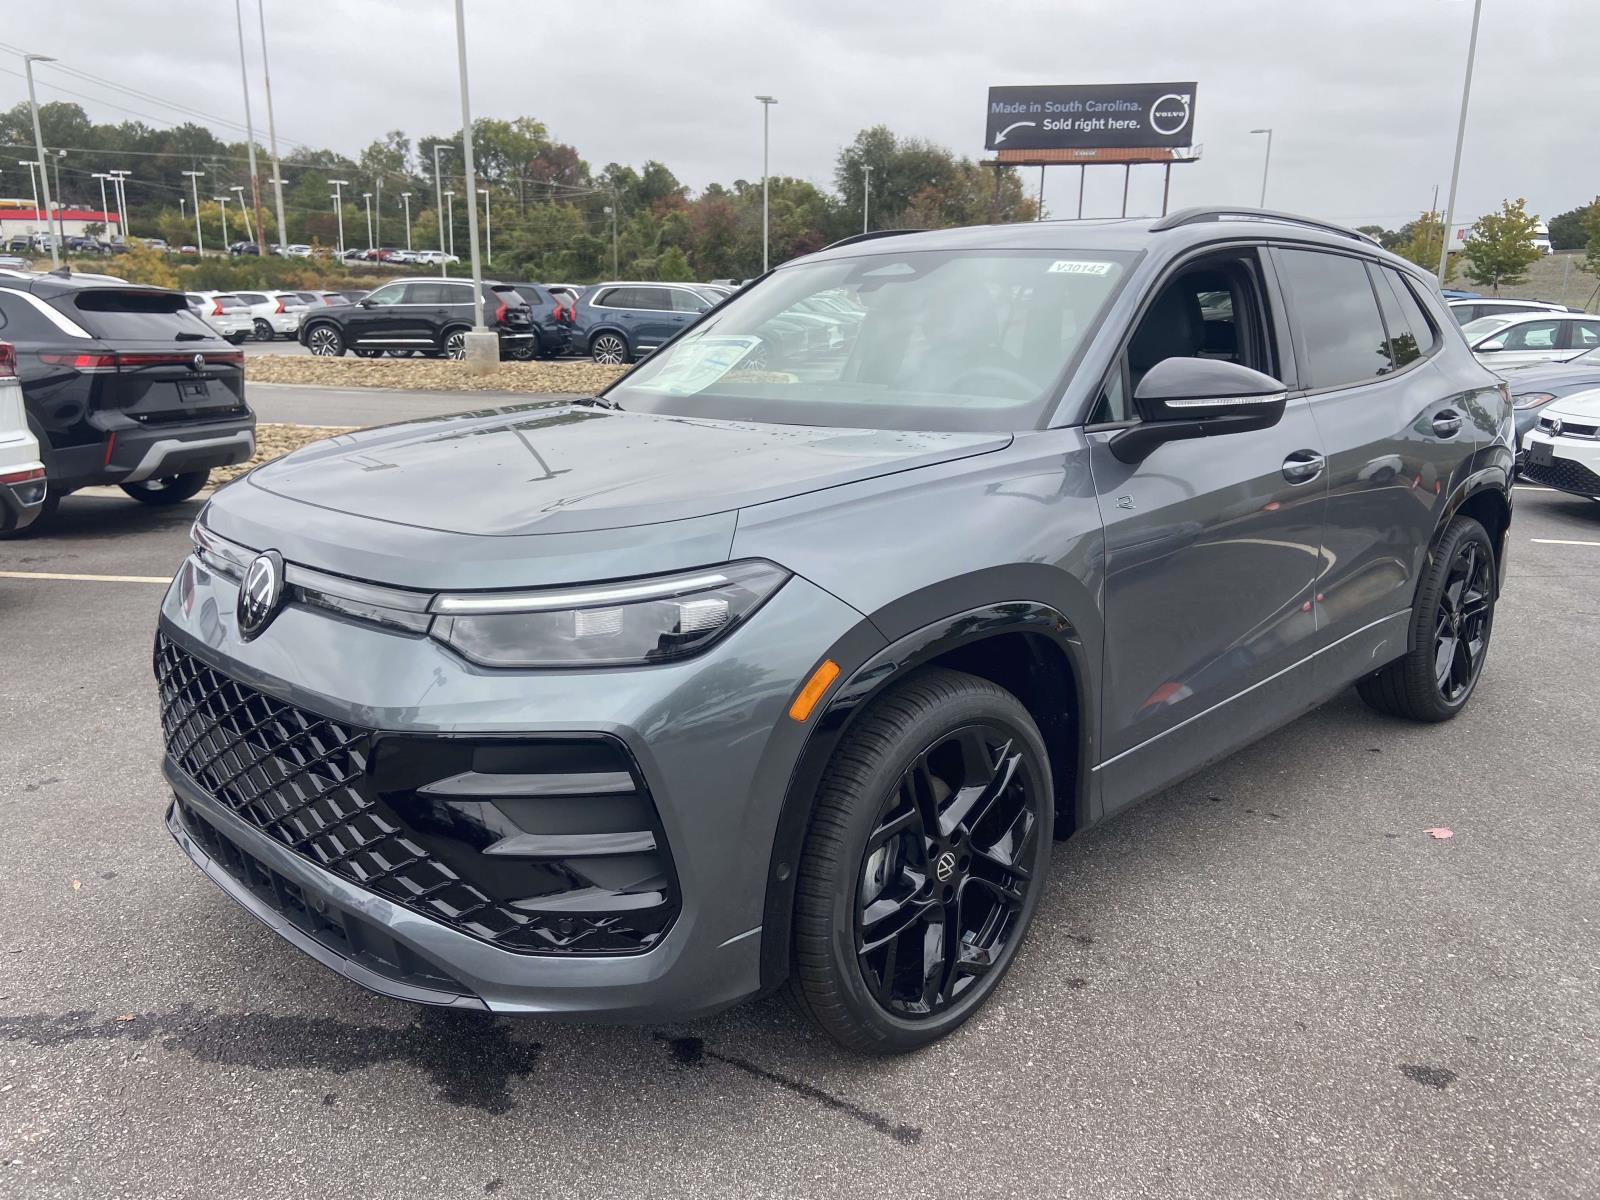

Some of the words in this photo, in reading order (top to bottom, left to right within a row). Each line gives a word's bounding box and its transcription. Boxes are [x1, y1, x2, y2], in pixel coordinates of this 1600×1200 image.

[992, 102, 1026, 113] Made
[1030, 101, 1041, 112] in
[1044, 101, 1082, 112] South
[1086, 100, 1142, 112] Carolina.
[1043, 118, 1072, 130] Sold
[1075, 118, 1105, 132] right
[1108, 118, 1140, 129] here.
[1055, 263, 1105, 273] V30142
